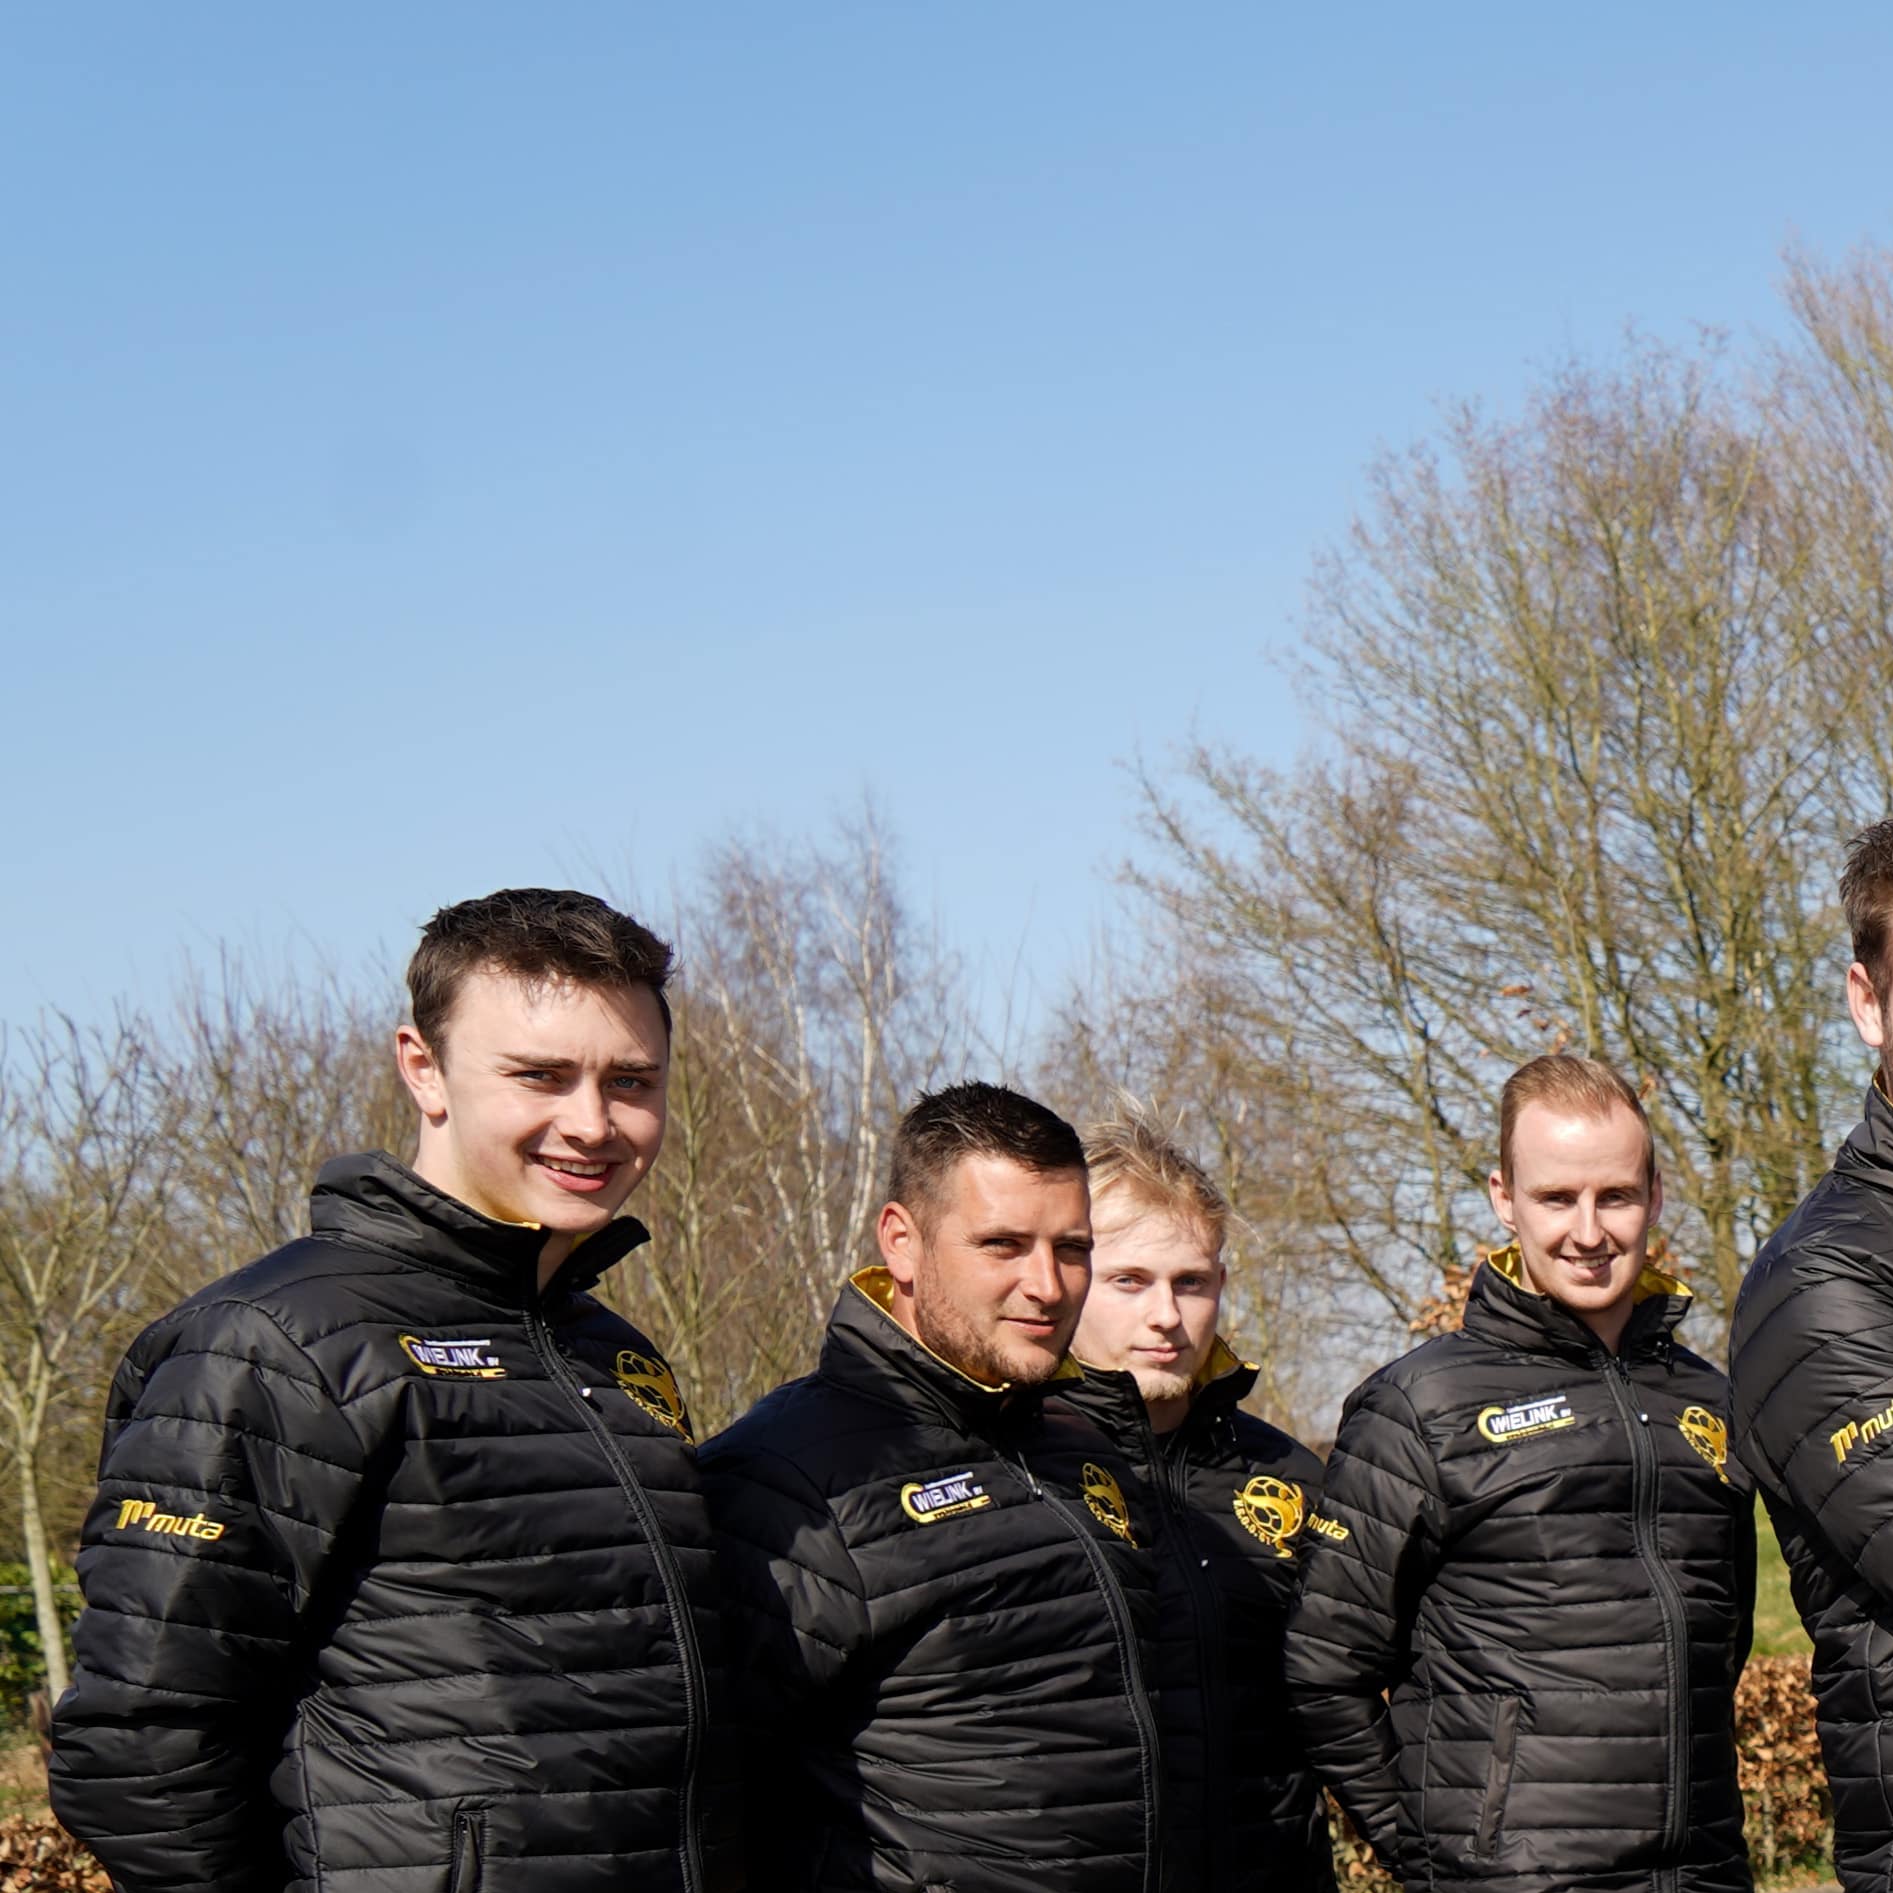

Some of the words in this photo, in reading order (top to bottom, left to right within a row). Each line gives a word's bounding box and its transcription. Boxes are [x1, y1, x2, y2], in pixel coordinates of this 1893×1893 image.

[1490, 1404, 1559, 1434] WIELINK
[911, 1481, 973, 1513] WIELINK
[145, 1512, 225, 1541] muta
